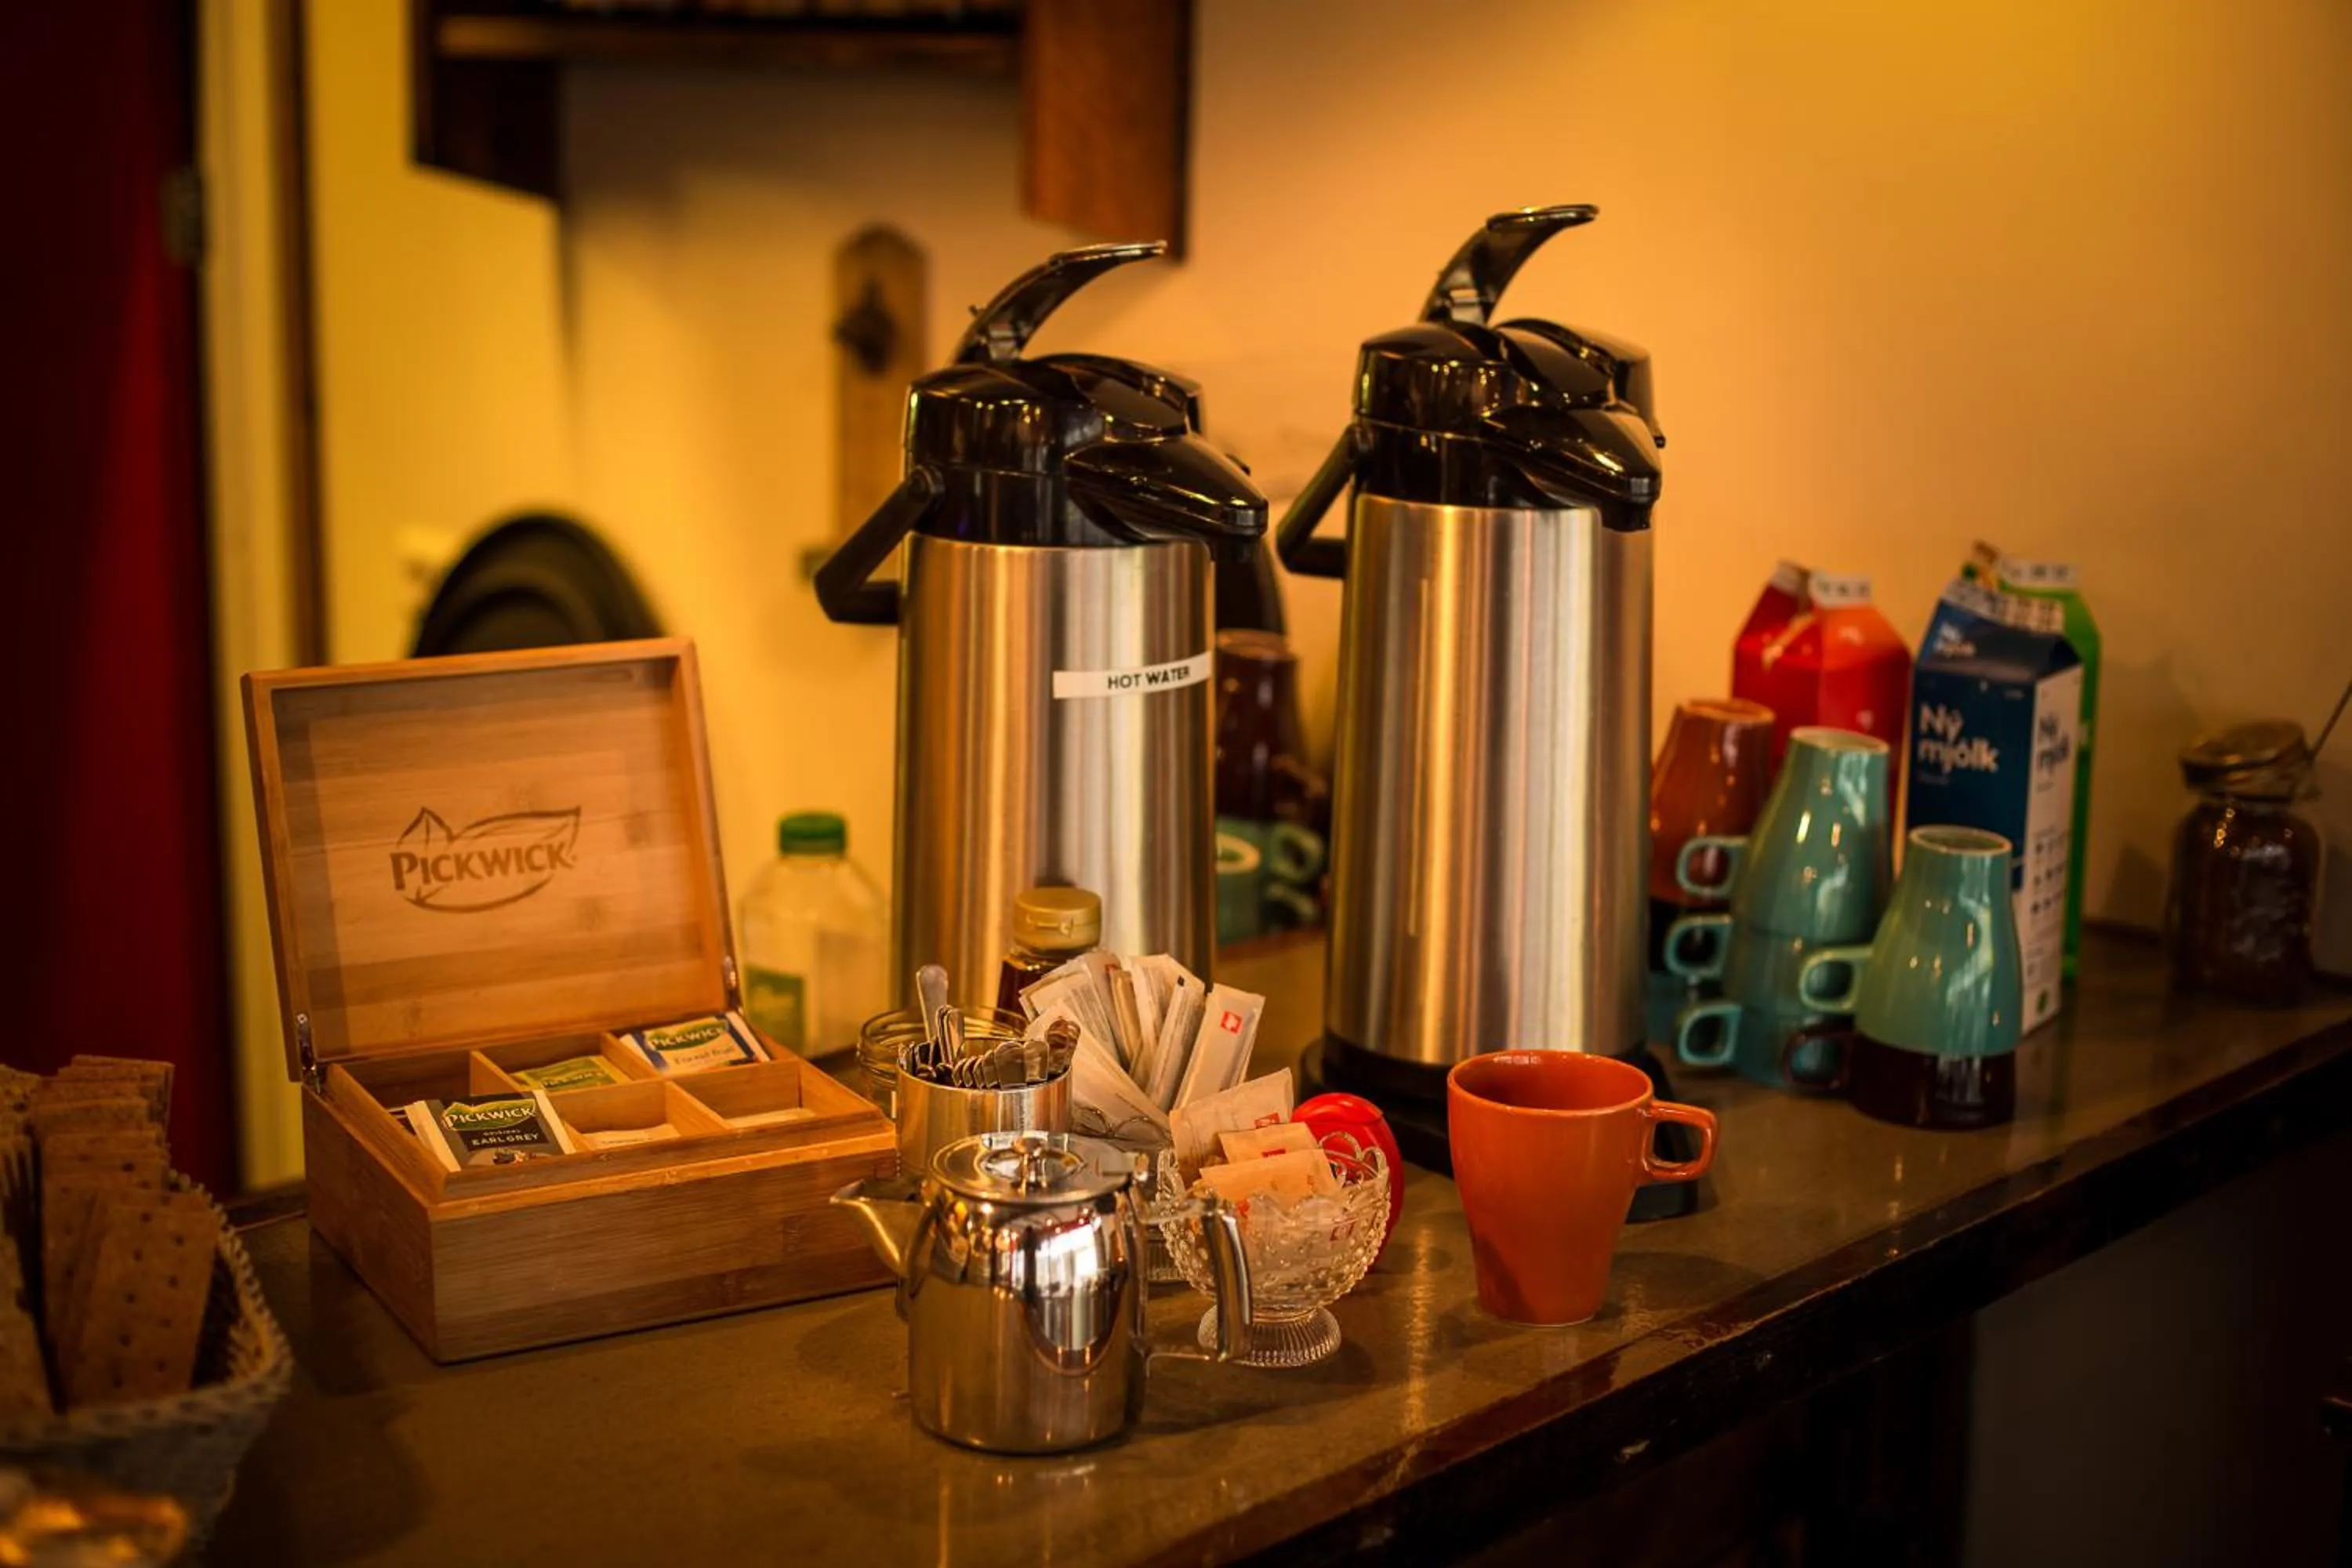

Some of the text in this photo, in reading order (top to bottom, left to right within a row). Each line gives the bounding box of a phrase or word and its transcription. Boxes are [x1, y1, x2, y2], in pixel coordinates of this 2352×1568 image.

[1107, 666, 1191, 690] HOT WATER
[390, 841, 575, 891] PICKWICK
[648, 1026, 722, 1051] PICKWICK
[444, 1107, 536, 1127] PICKWICK
[471, 1133, 539, 1146] EARL GREY
